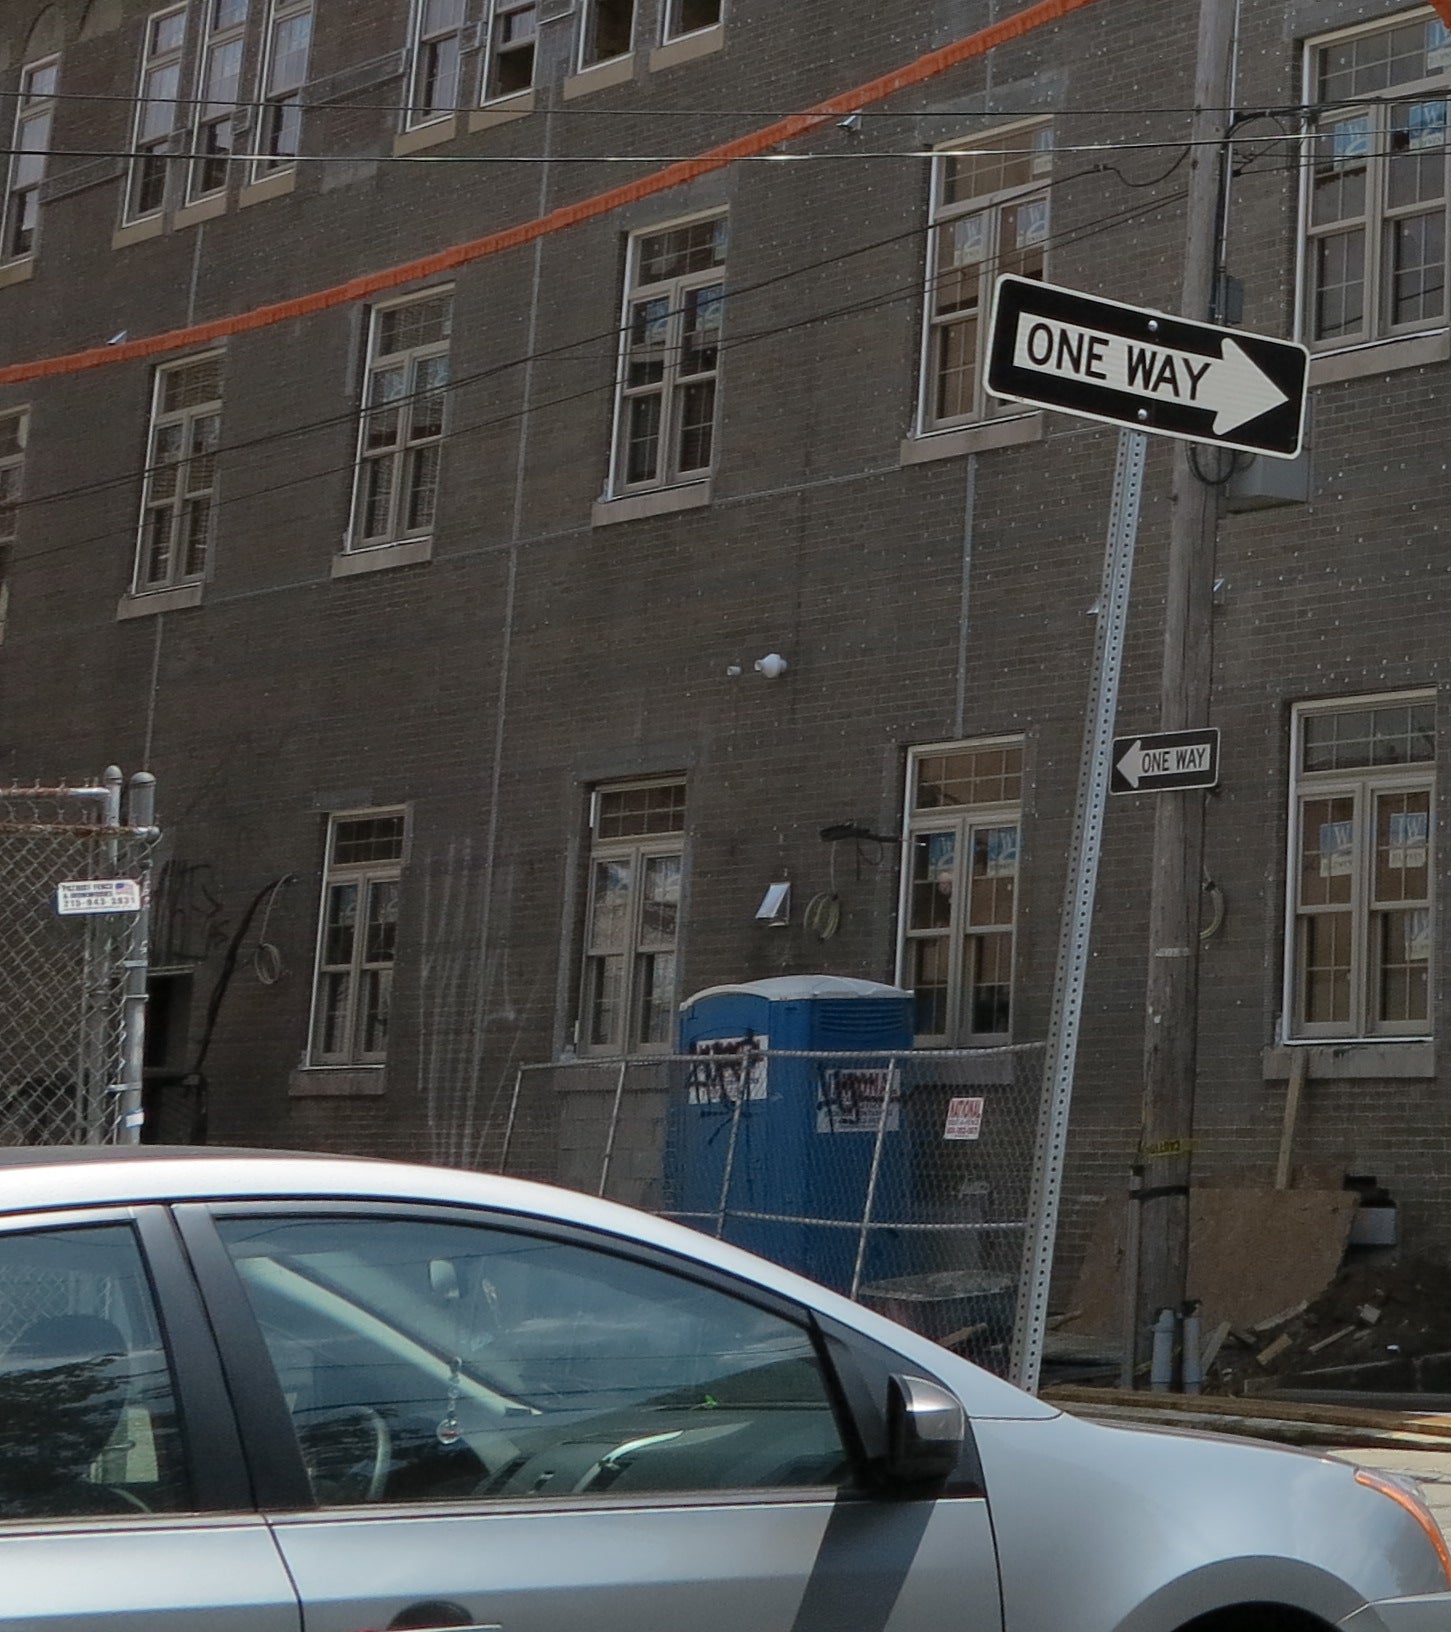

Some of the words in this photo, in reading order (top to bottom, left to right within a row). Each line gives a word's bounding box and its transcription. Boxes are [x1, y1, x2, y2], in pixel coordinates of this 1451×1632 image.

[1026, 322, 1110, 381] ONE
[1126, 344, 1212, 402] WAY
[1142, 751, 1171, 774] ONE
[1176, 747, 1206, 771] WAY
